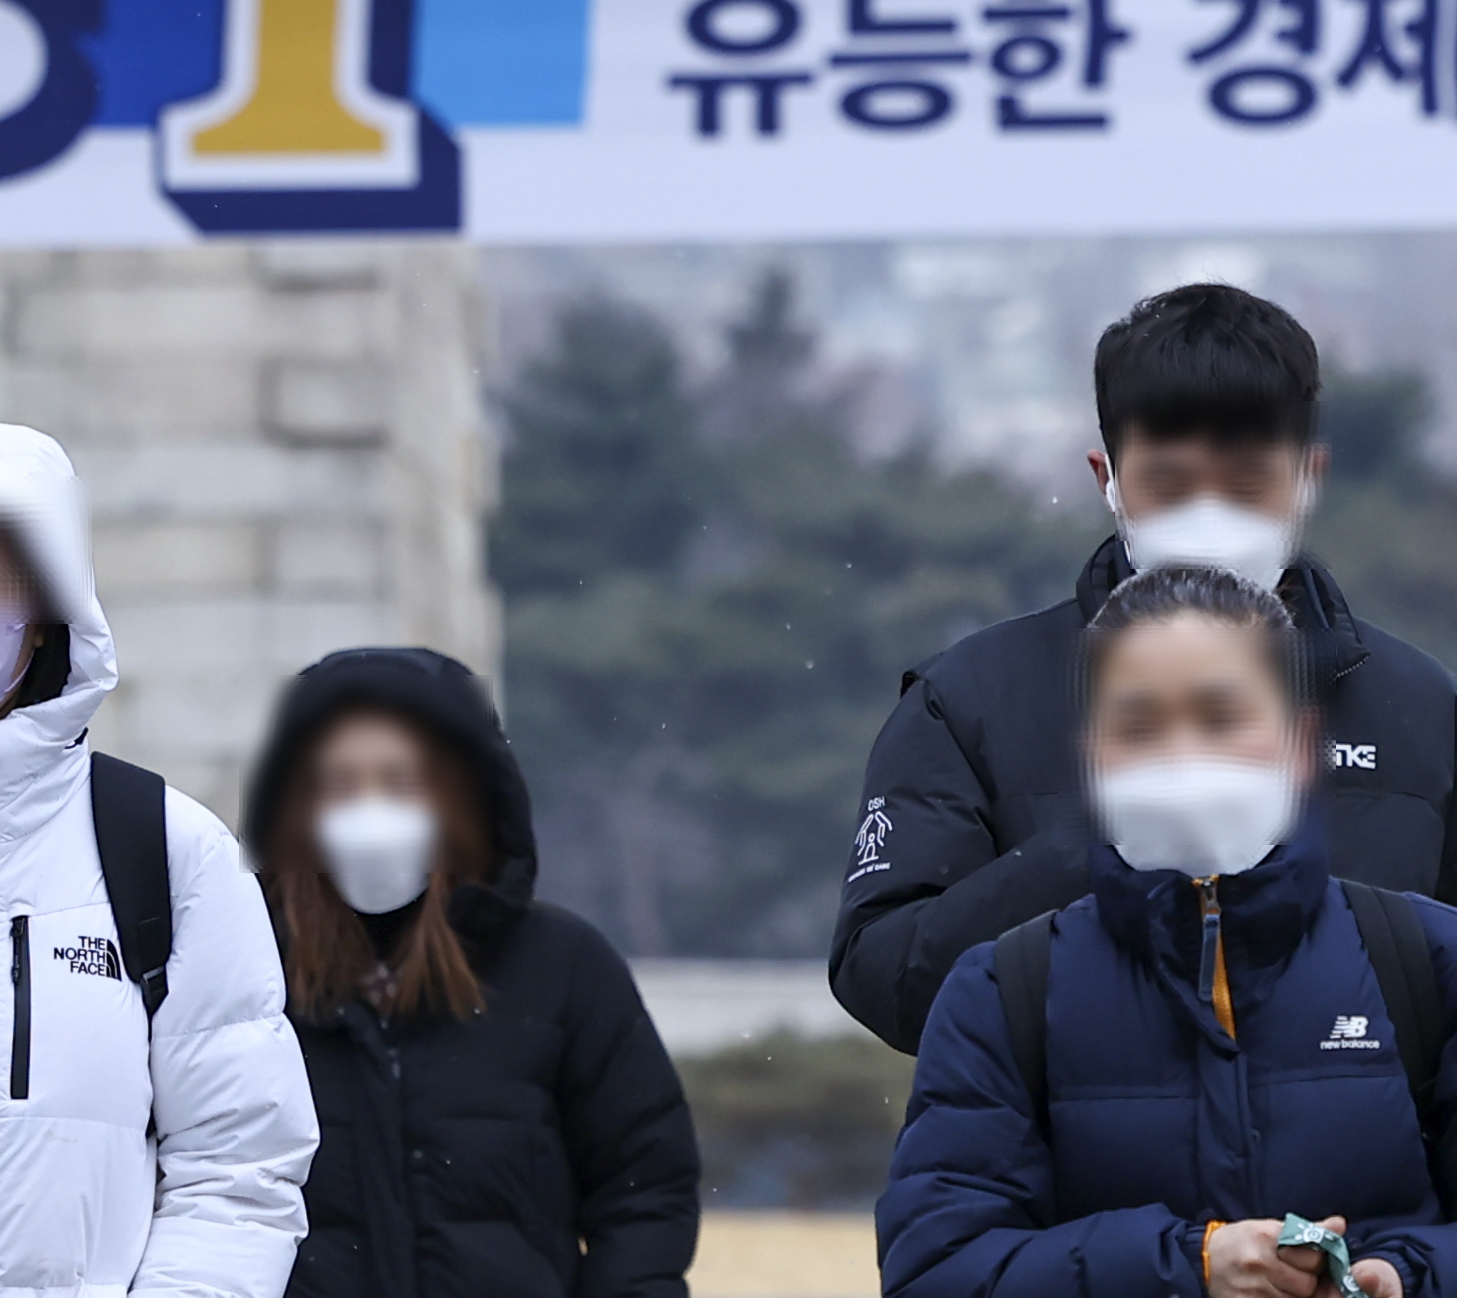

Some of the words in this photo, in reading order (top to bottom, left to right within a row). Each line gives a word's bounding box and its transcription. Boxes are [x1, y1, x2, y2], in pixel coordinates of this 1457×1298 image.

[77, 935, 106, 951] THE
[53, 947, 106, 963] NORTH
[70, 960, 106, 977] FACE
